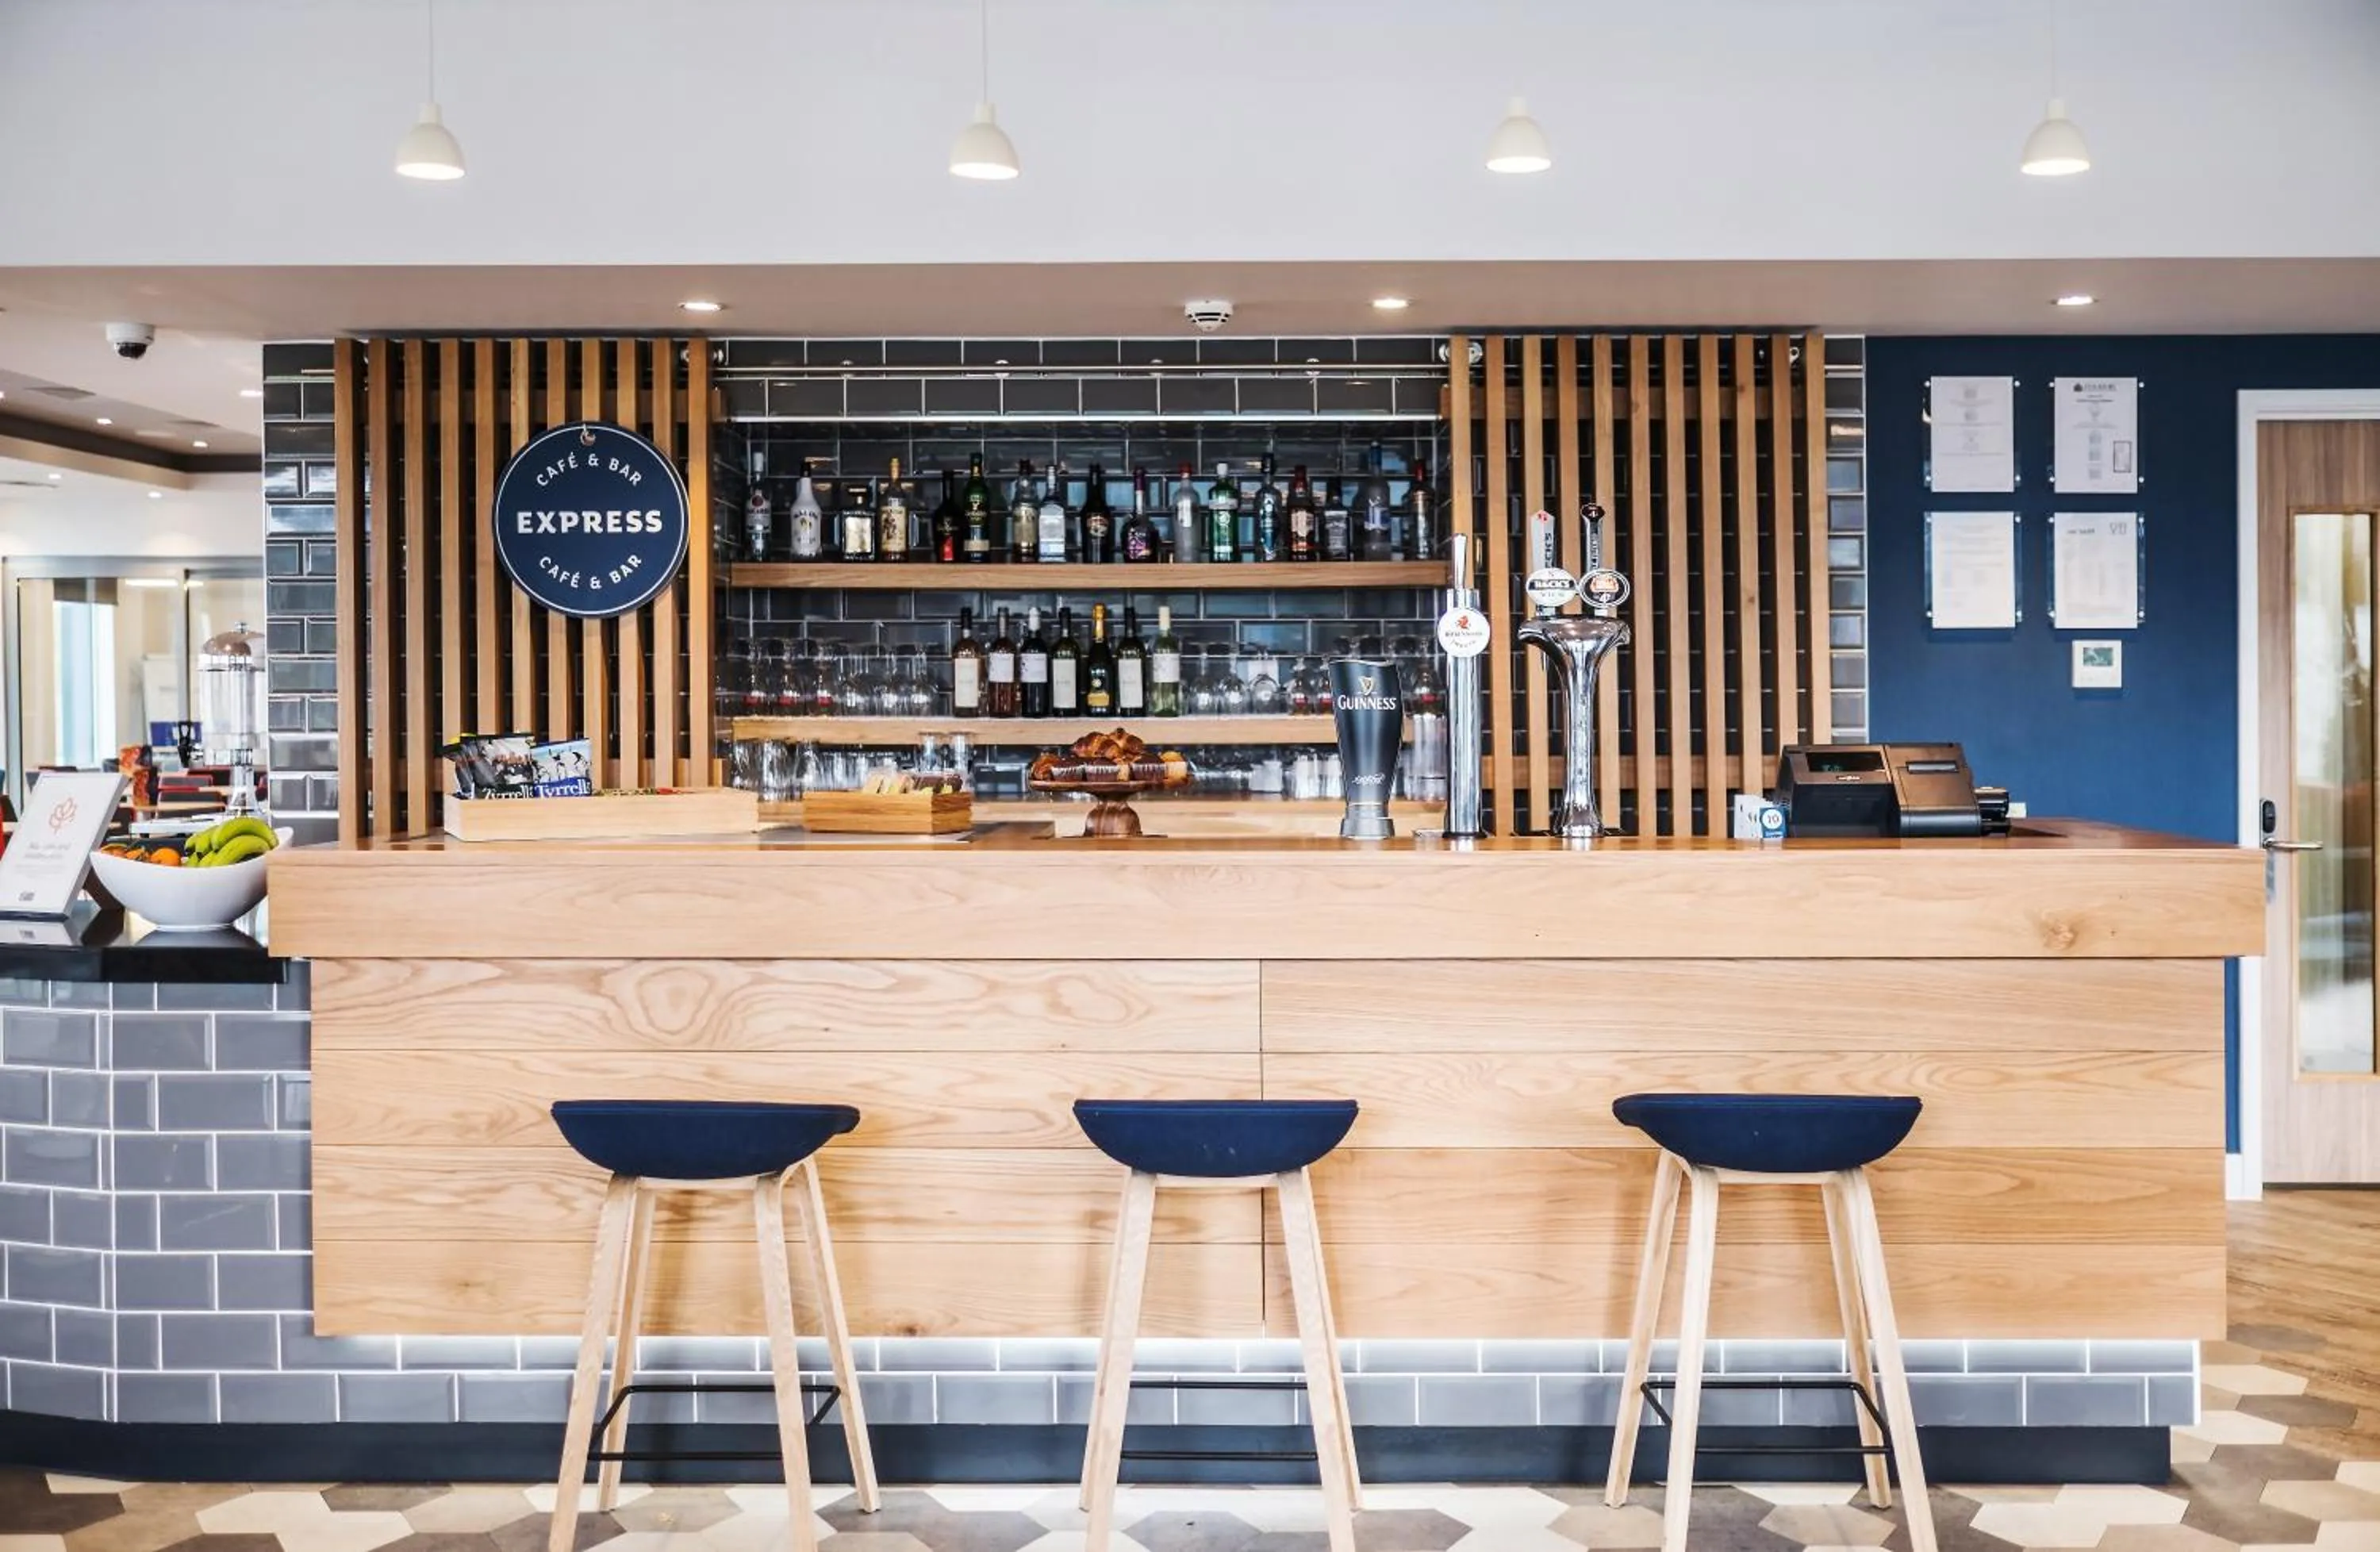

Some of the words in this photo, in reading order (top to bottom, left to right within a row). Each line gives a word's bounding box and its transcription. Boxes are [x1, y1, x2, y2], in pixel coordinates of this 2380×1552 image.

[537, 451, 578, 486] CAFÉ
[588, 453, 599, 467] &
[608, 457, 642, 486] BAR
[516, 510, 662, 534] EXPRESS
[539, 556, 580, 588] CAFÉ
[589, 577, 601, 590] &
[609, 555, 642, 584] BAR
[1338, 695, 1396, 710] GUINNESS
